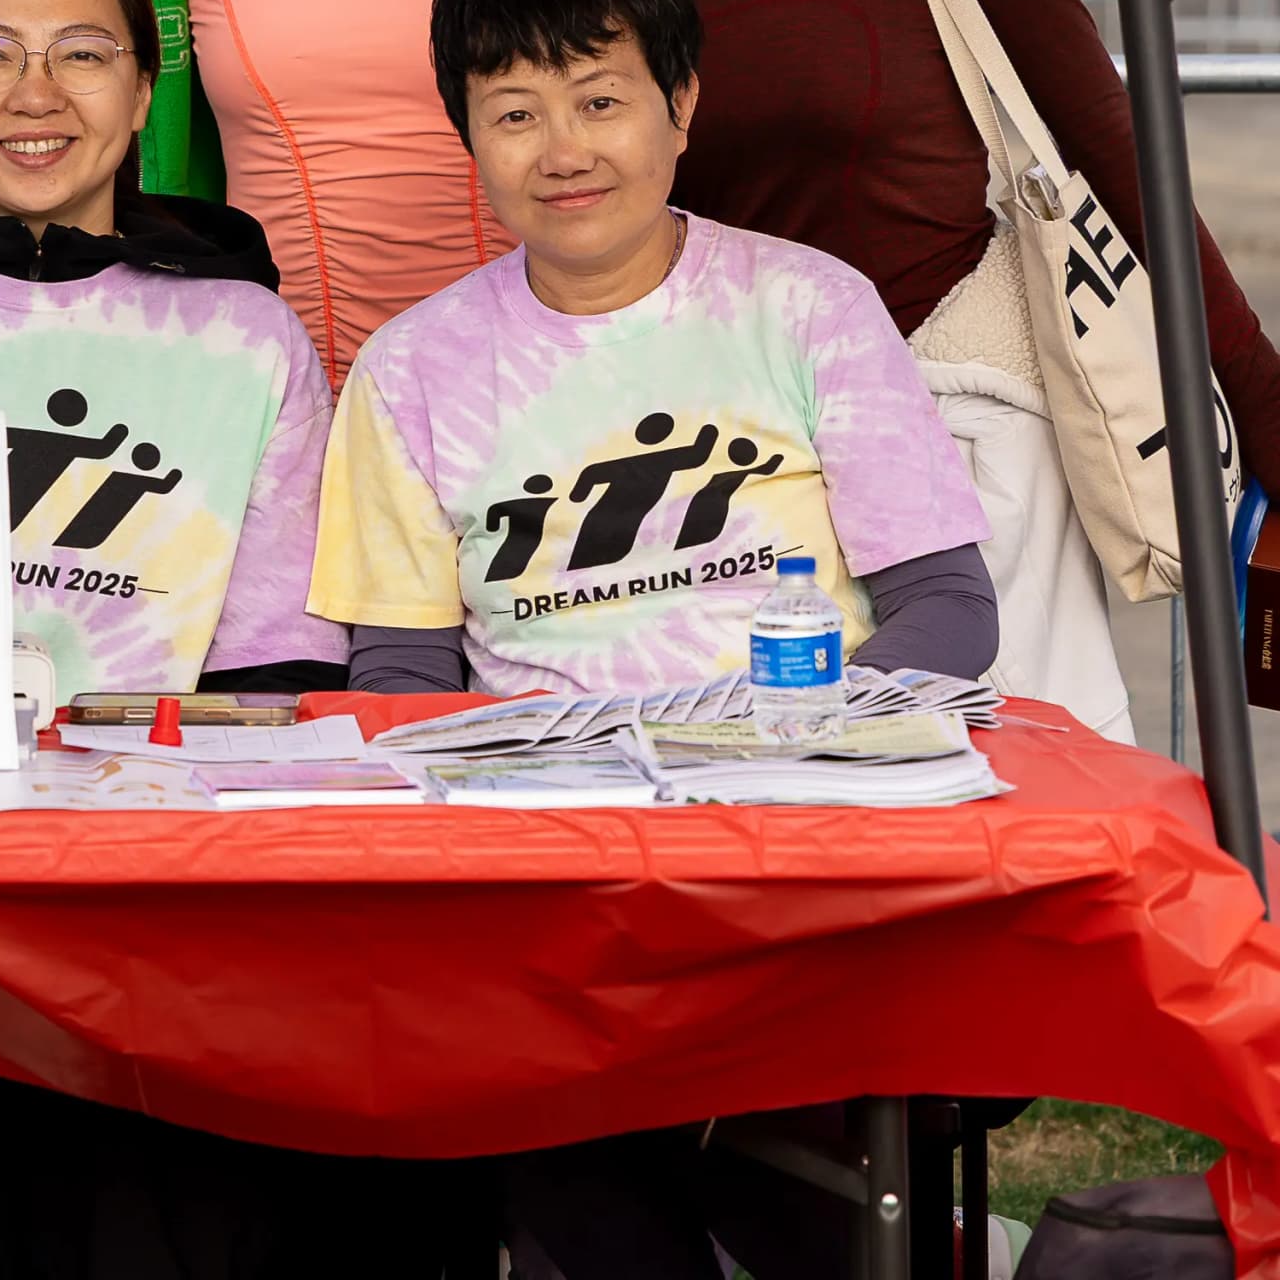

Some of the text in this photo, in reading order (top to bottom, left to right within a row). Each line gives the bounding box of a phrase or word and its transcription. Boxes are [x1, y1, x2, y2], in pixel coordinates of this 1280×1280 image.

[11, 561, 139, 599] UN 2025
[513, 544, 775, 621] DREAM RUN 2025
